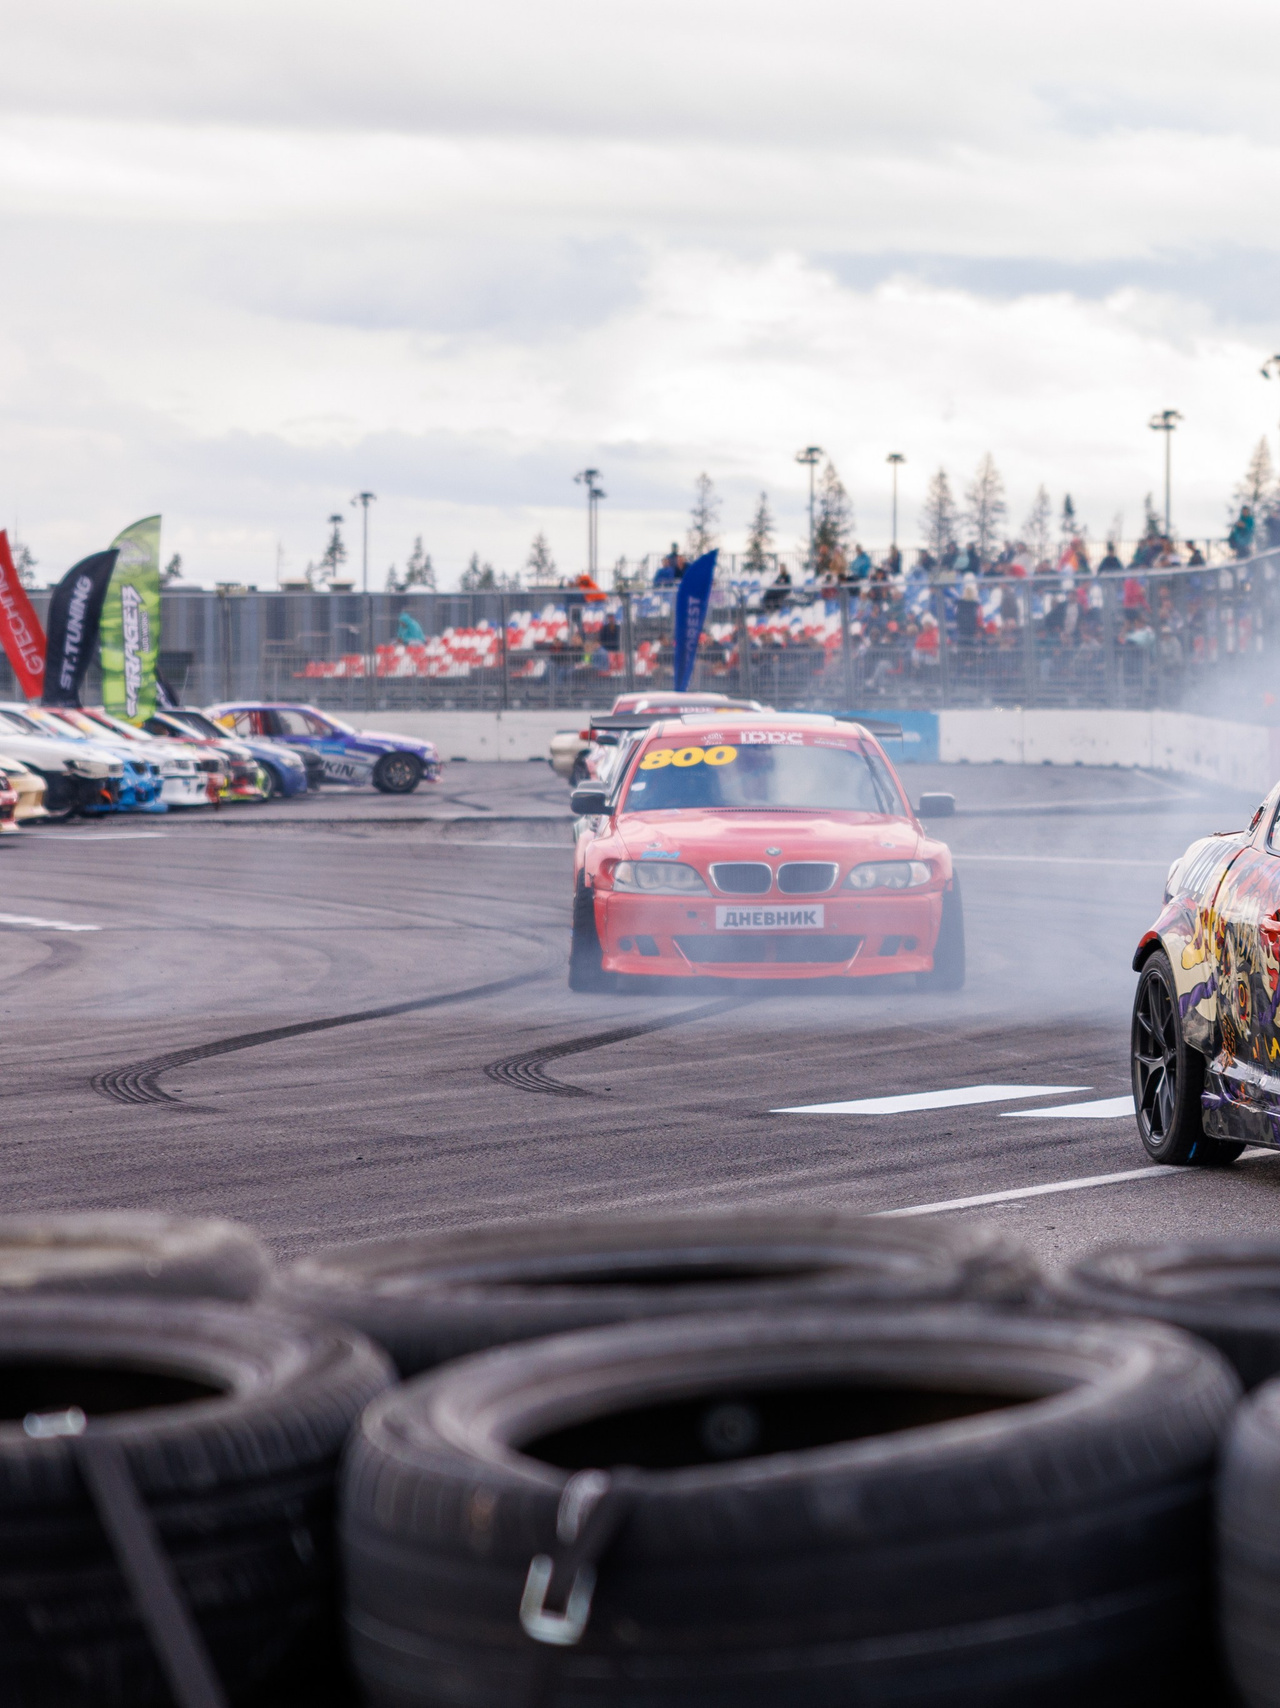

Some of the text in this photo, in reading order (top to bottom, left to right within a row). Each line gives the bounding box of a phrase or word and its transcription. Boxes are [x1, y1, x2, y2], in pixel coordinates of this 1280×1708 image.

[0, 563, 44, 675] GTECHNI
[60, 574, 94, 691] ST.TUNING
[639, 745, 738, 770] 800
[723, 910, 817, 927] ДНЕВНИК
